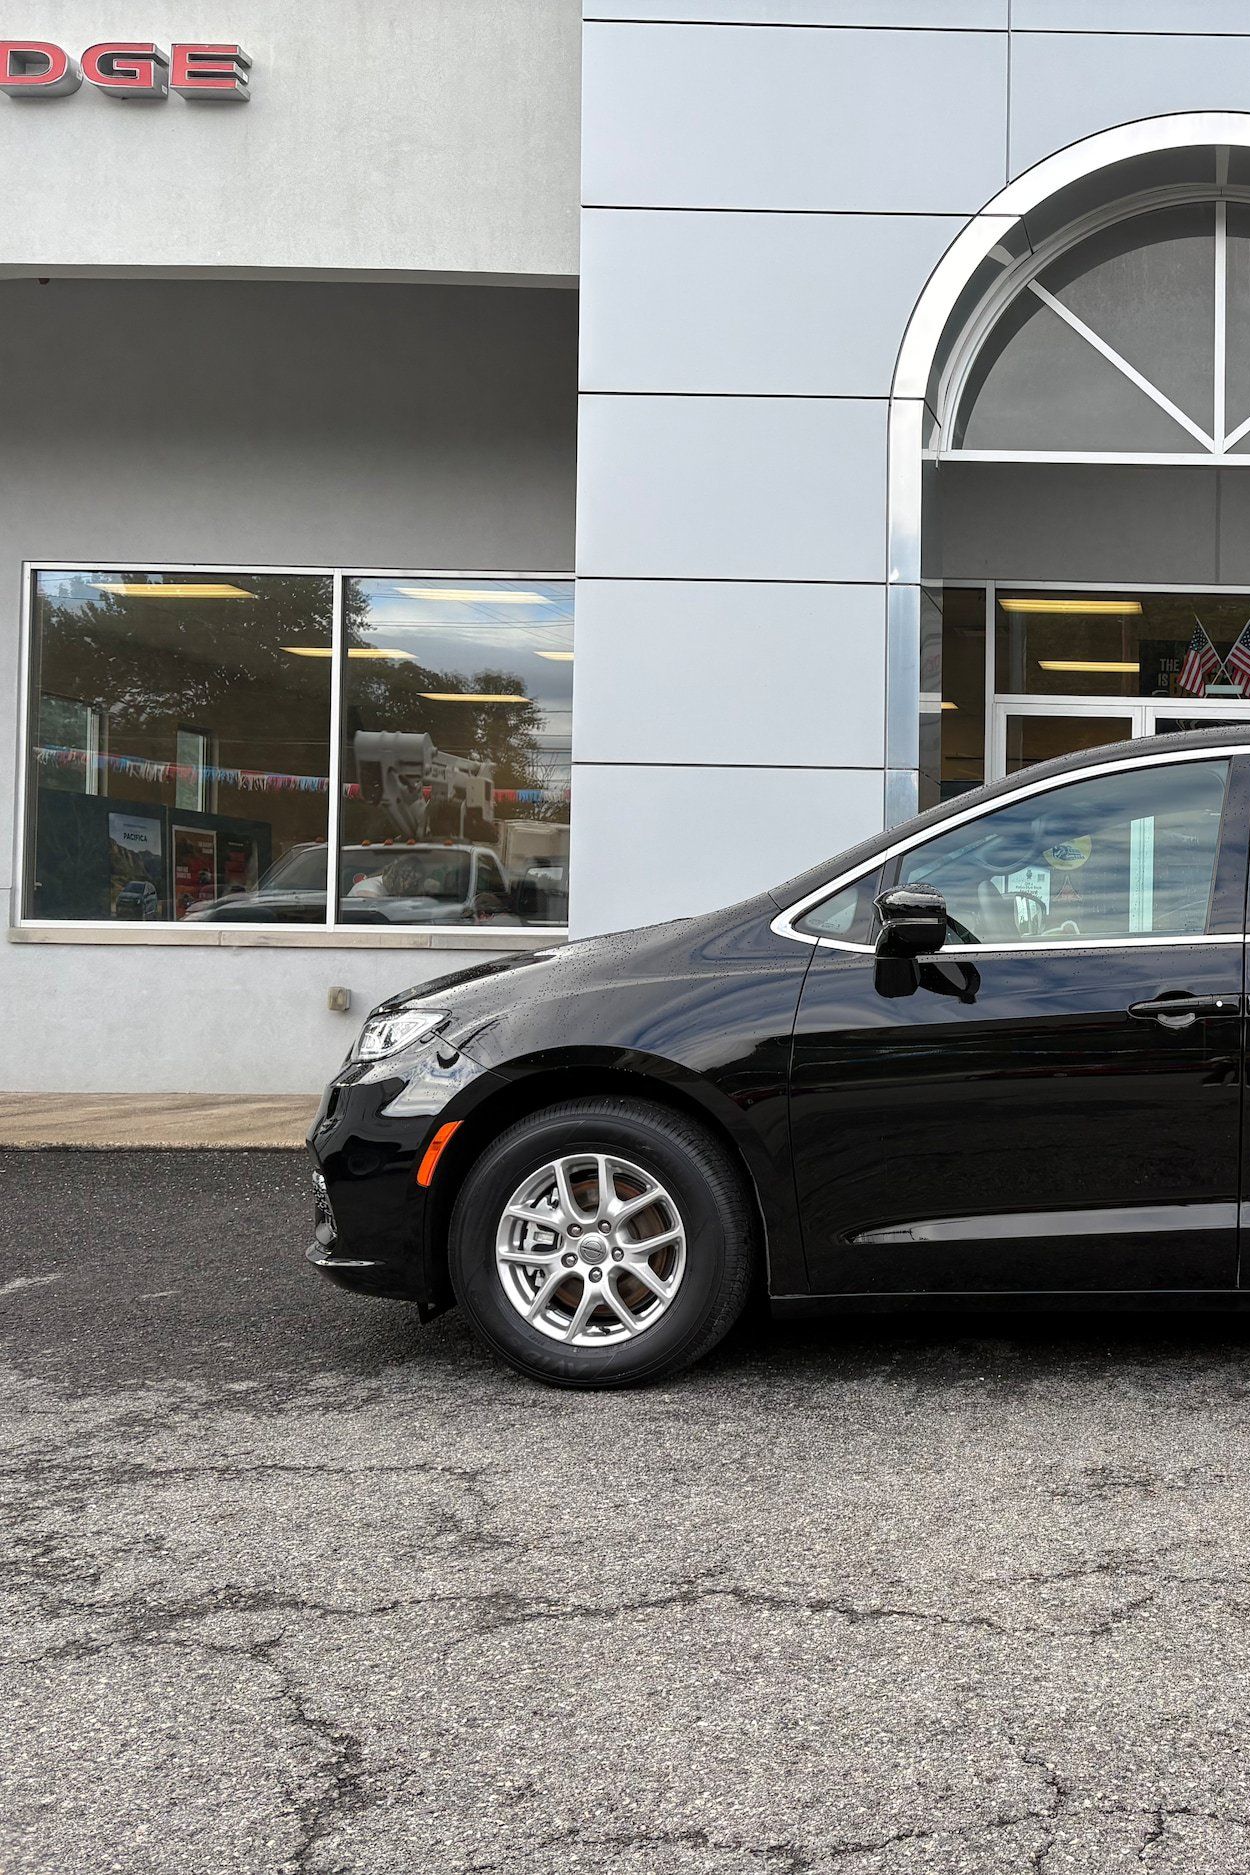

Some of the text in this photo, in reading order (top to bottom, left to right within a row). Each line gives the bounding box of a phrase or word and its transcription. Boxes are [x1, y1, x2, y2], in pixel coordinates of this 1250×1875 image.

[1159, 658, 1180, 672] THE
[1157, 673, 1169, 687] IS
[123, 832, 147, 842] PACIFICA
